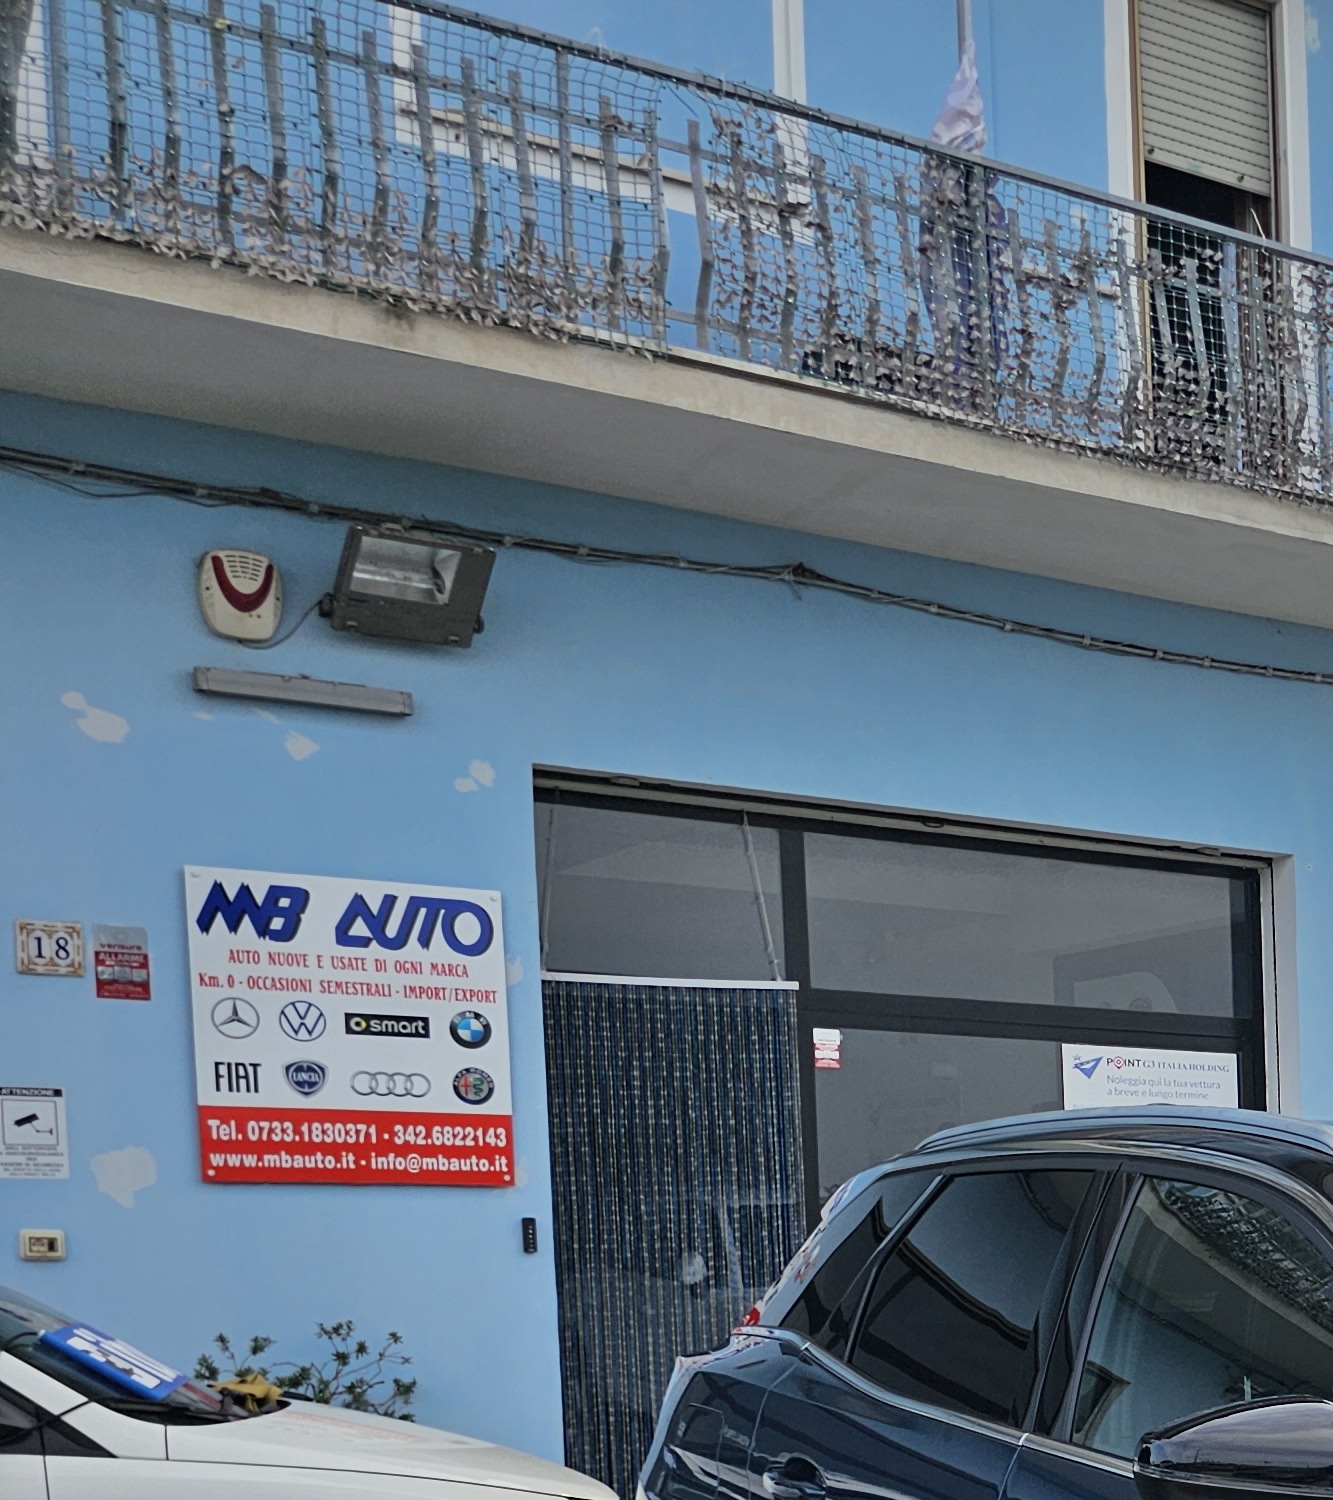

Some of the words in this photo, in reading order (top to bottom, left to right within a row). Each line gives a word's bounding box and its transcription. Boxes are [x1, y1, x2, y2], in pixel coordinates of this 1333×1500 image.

[196, 879, 310, 942] MB
[335, 892, 494, 957] AUTO
[33, 936, 70, 960] 18
[228, 949, 261, 965] AUTO
[268, 951, 310, 968] NUOVE
[316, 954, 325, 969] E
[330, 955, 368, 972] USATE
[374, 958, 387, 973] DI
[394, 959, 423, 975] OGNI
[430, 962, 469, 978] MARCA
[198, 972, 224, 988] Km.
[247, 975, 312, 993] OCCASIONI
[319, 980, 392, 998] SEMESTRALI
[403, 984, 497, 1004] IMPORT/EXPORT
[369, 1017, 426, 1034] smart
[214, 1061, 262, 1093] FIAT
[292, 1071, 320, 1082] LANCIA
[1158, 1061, 1188, 1070] ITALIA
[1189, 1063, 1230, 1073] HOLDING
[1106, 1075, 1146, 1087] Noleggia
[1148, 1077, 1162, 1087] qui
[1164, 1078, 1171, 1086] la
[1173, 1079, 1188, 1088] tua
[1189, 1081, 1221, 1089] vettura
[1114, 1087, 1140, 1097] breve
[1149, 1088, 1174, 1100] lungo
[1175, 1090, 1209, 1100] termine
[207, 1119, 243, 1141] Tel.
[247, 1120, 377, 1144] 0733.1830371
[393, 1124, 507, 1147] 342.6822143
[209, 1150, 356, 1169] www.mbauto.it
[371, 1152, 508, 1173] info@mbauto.it
